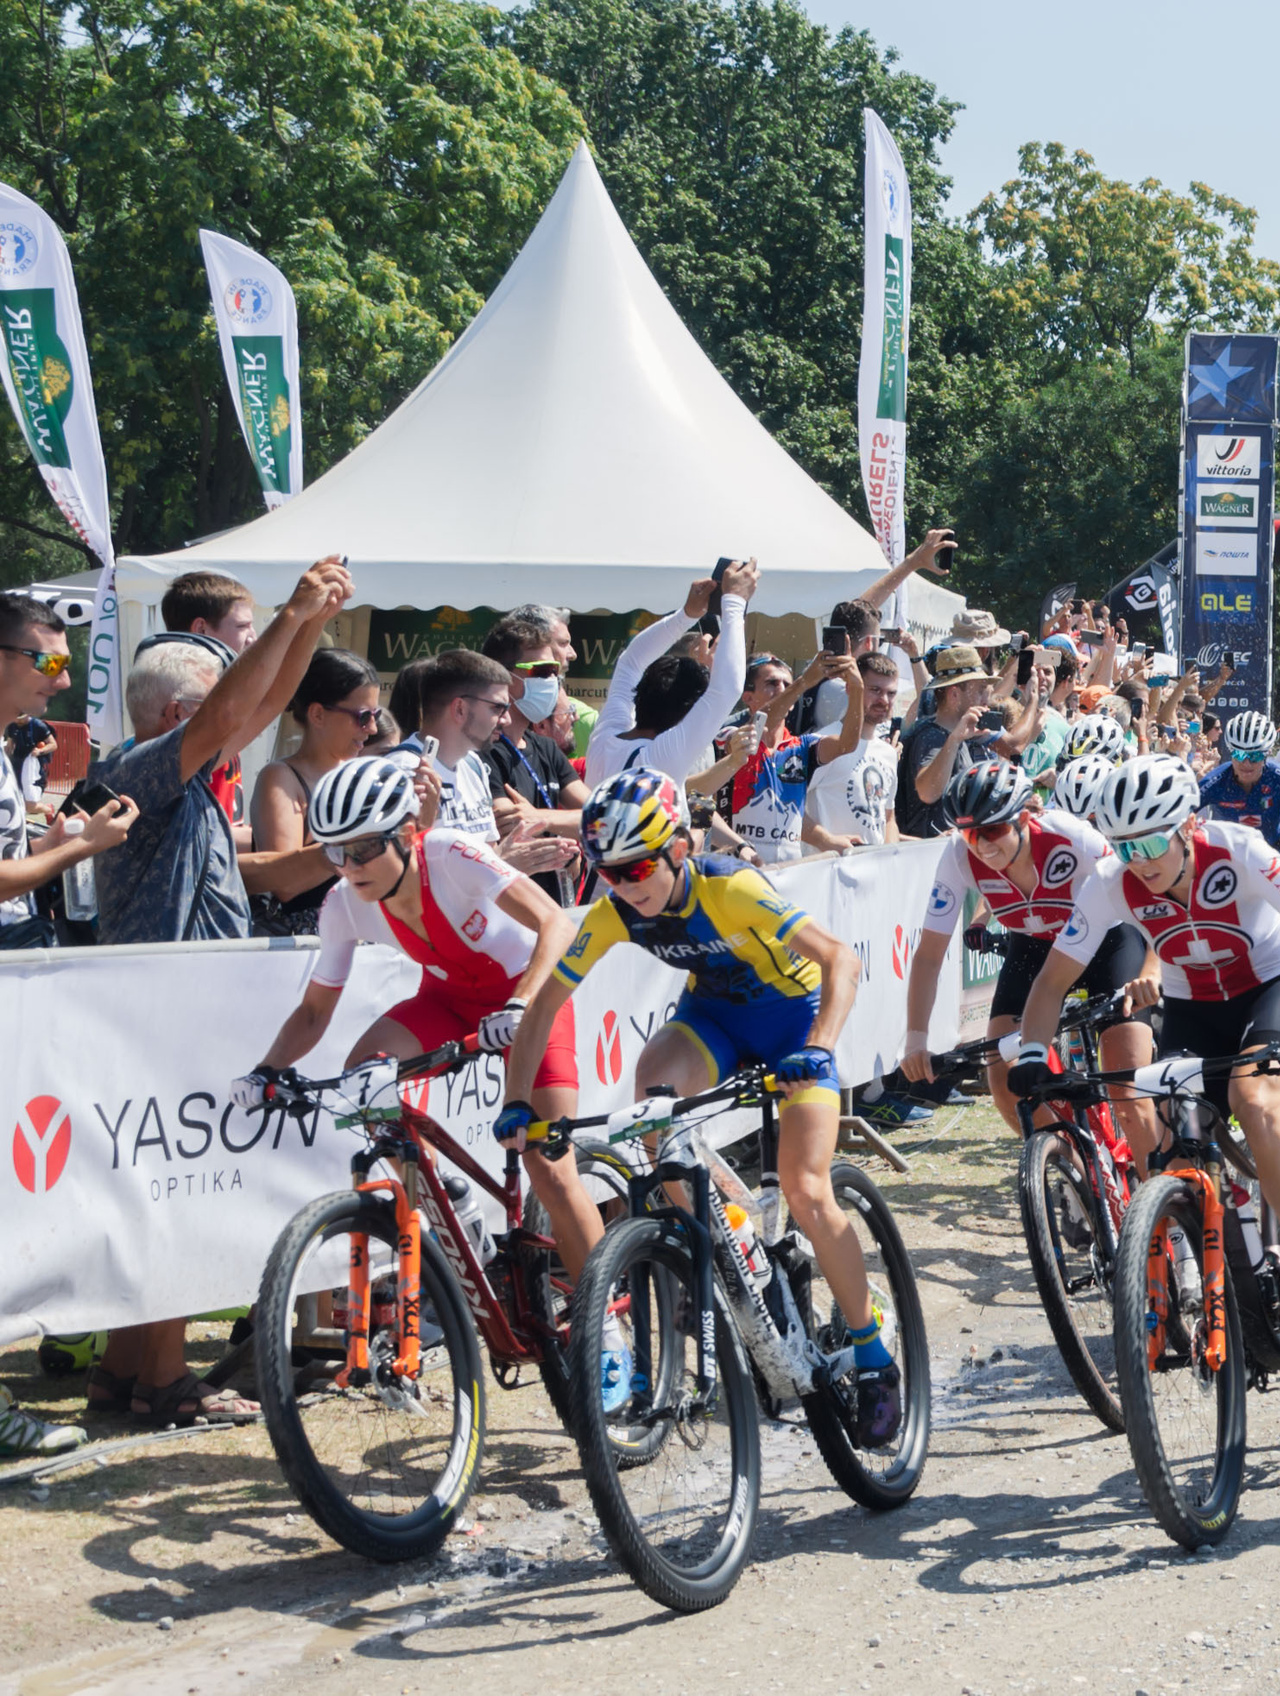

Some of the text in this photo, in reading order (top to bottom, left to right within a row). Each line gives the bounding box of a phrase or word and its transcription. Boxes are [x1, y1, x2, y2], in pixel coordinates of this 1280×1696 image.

[1206, 464, 1252, 476] vittoria
[1205, 503, 1250, 514] WAGNER
[735, 823, 766, 838] MTB
[358, 1071, 373, 1105] 7
[1159, 1063, 1178, 1088] 4
[94, 1087, 324, 1170] YASON
[150, 1169, 243, 1202] OPTIKA
[403, 1298, 420, 1338] FOX
[1205, 1289, 1226, 1331] FOX
[702, 1309, 715, 1347] SWISS
